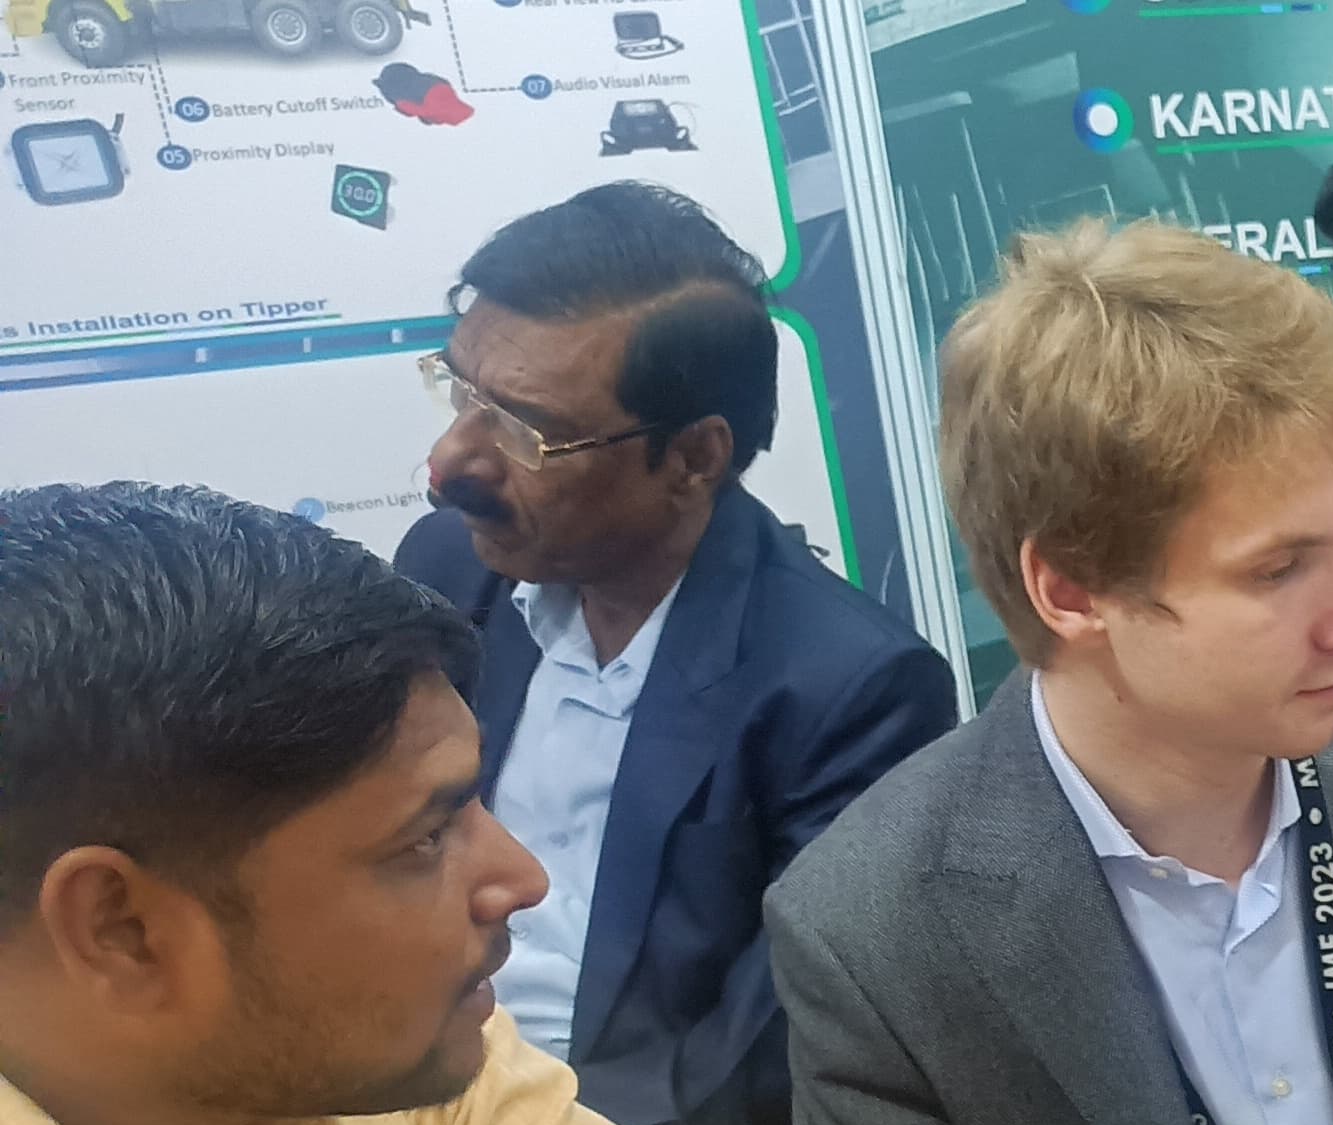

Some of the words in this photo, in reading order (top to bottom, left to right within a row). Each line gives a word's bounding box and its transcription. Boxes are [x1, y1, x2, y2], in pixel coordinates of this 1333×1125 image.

[8, 70, 57, 87] Front
[62, 67, 147, 87] Proximity
[553, 77, 598, 93] Audio
[600, 75, 647, 89] Visual
[648, 73, 691, 87] Alarm
[15, 97, 76, 113] Sensor
[181, 102, 205, 118] 06
[212, 102, 273, 120] Battery
[277, 98, 327, 116] Cutoff
[331, 94, 385, 111] Switch
[163, 149, 187, 165] 05
[192, 144, 271, 163] Proximity
[275, 141, 335, 158] Display
[28, 308, 191, 338] Installation
[198, 306, 233, 322] on
[241, 298, 329, 321] Tipper
[327, 496, 384, 515] Beacon
[387, 489, 424, 508] Light
